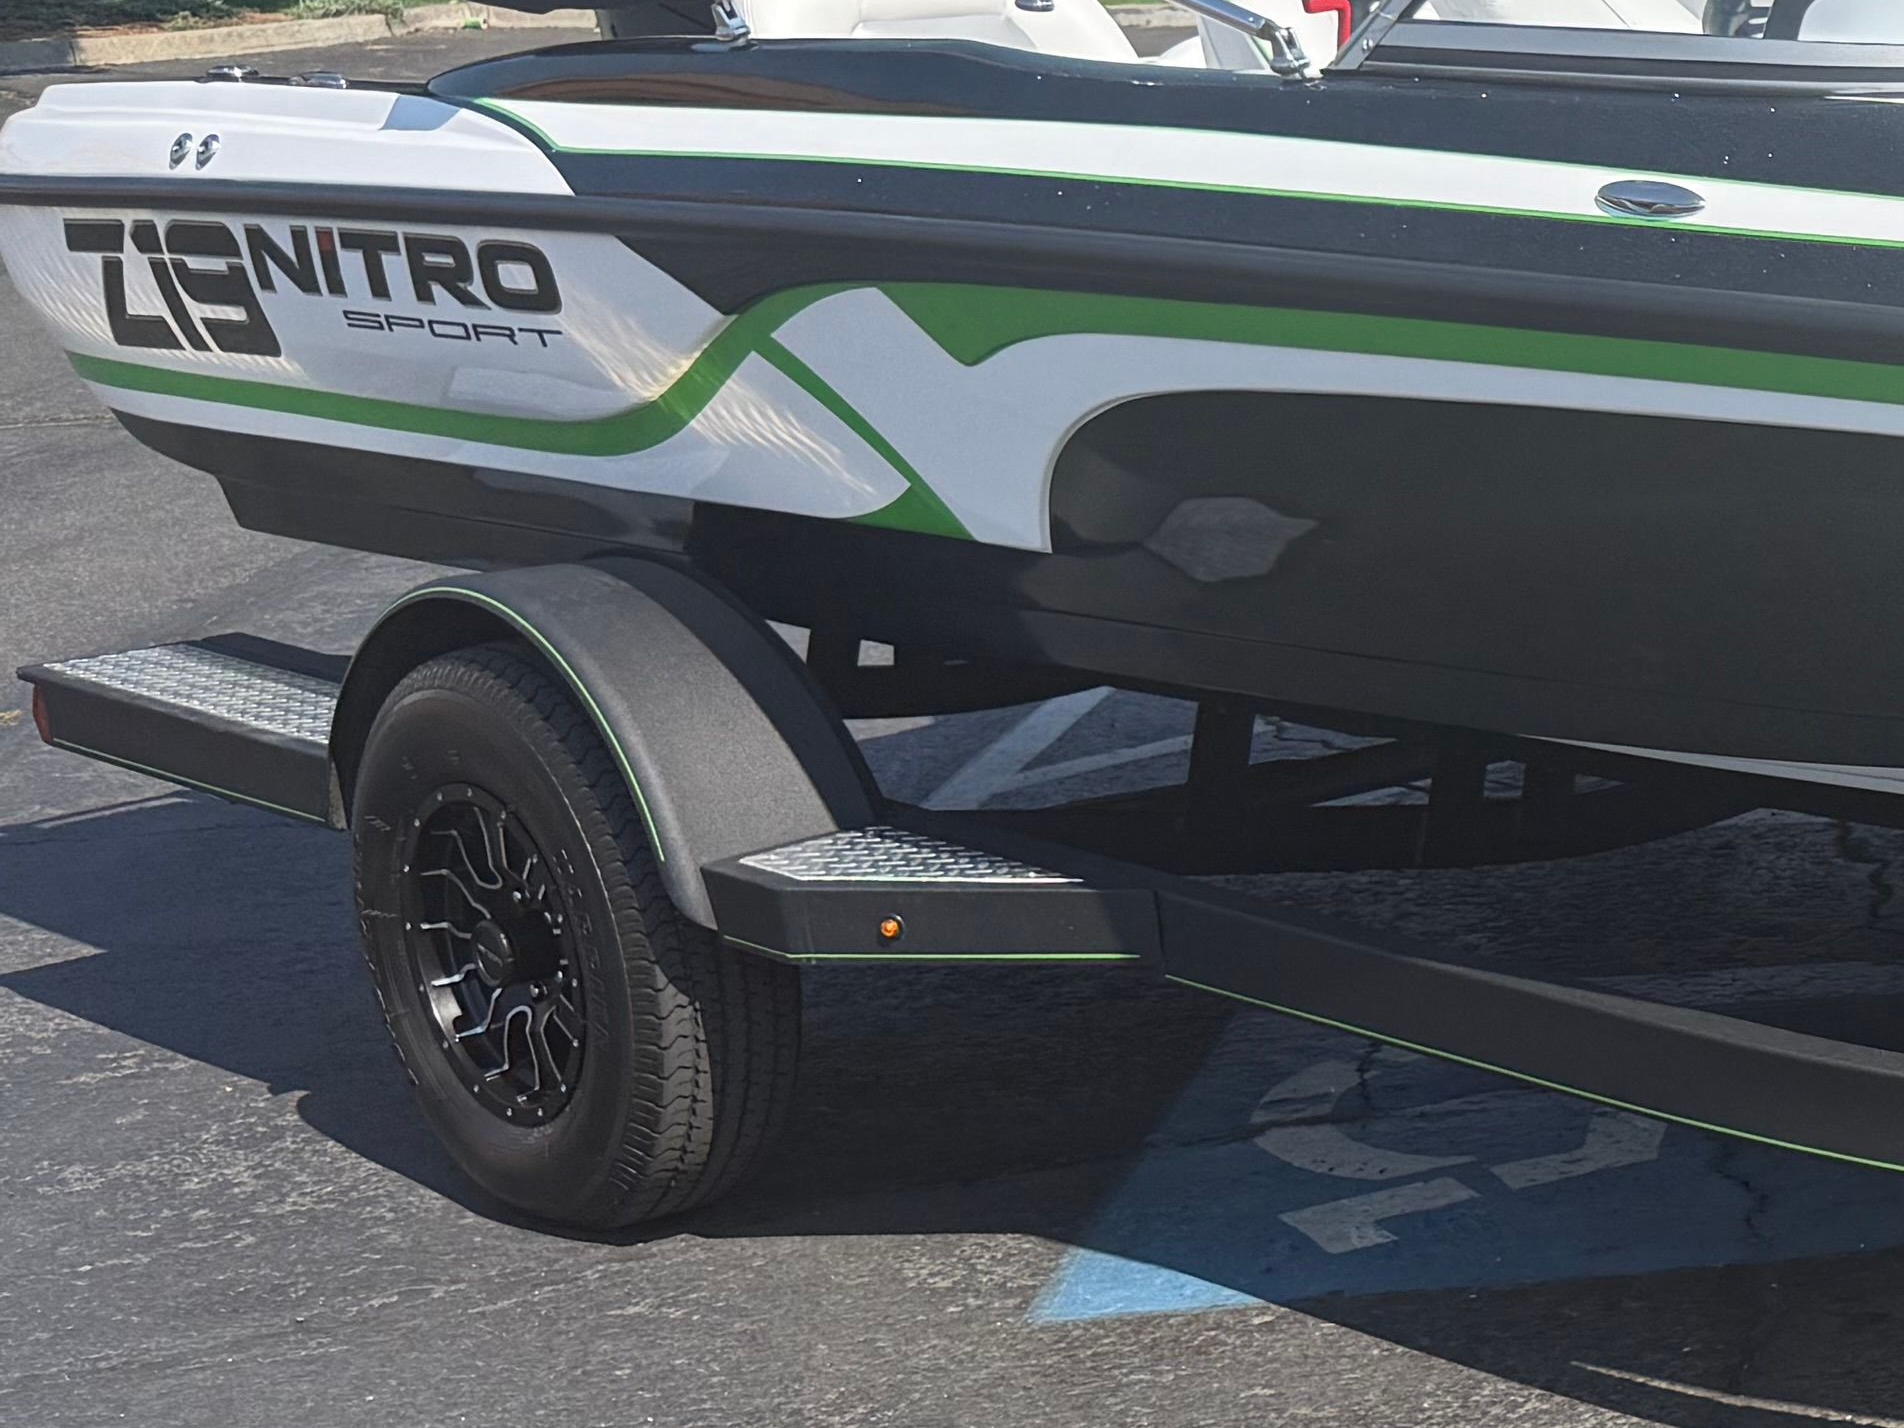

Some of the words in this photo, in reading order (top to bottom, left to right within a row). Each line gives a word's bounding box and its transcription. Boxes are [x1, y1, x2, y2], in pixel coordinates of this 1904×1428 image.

[63, 217, 283, 357] Z19
[245, 224, 564, 316] NITRO
[343, 308, 565, 348] SPORT
